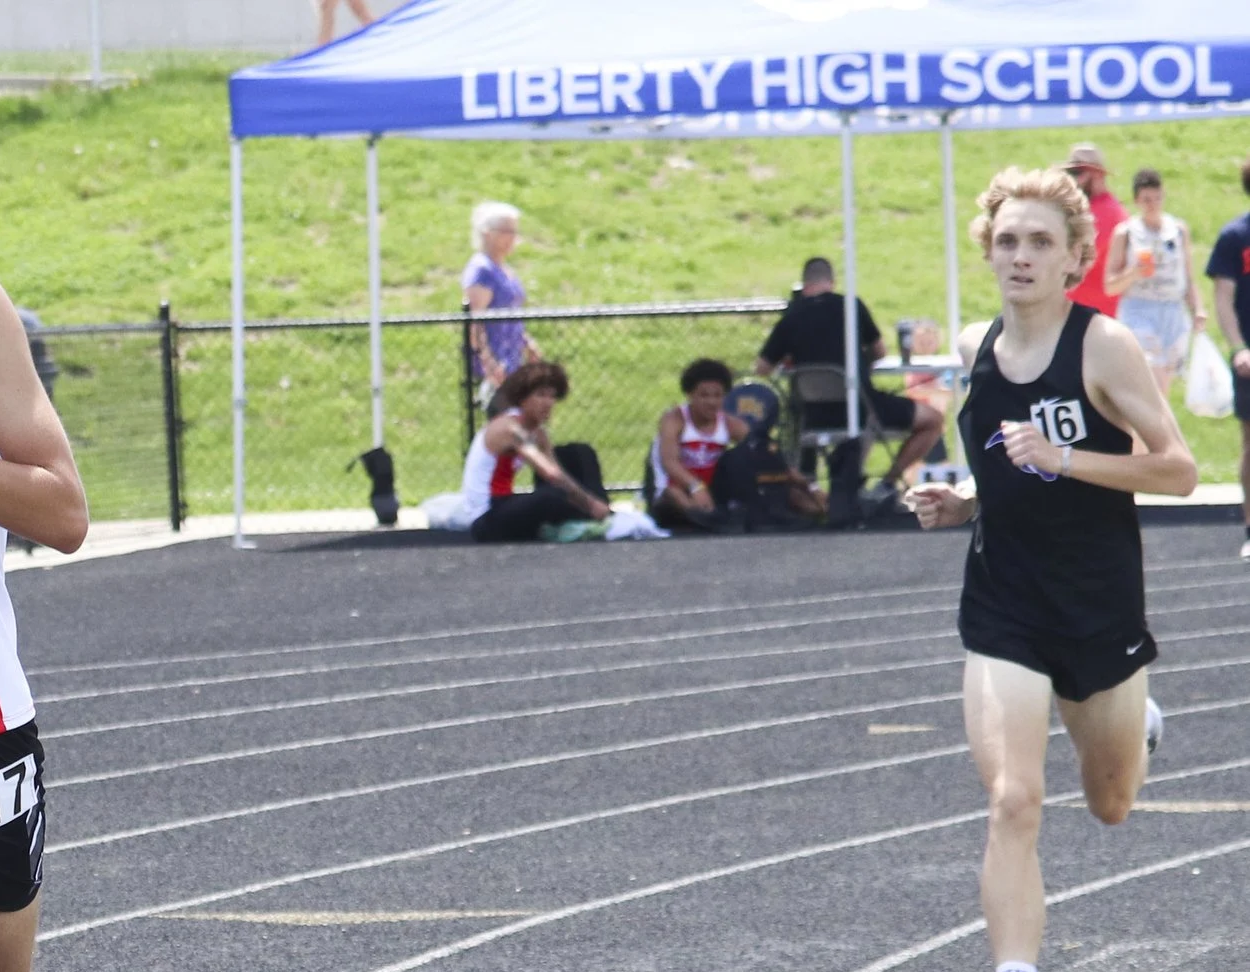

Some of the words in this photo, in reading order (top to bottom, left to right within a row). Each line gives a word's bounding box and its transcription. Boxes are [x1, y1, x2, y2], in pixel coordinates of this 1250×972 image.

[461, 57, 733, 120] LIBERTY
[752, 50, 921, 107] HIGH
[939, 45, 1232, 101] SCHOOL
[1035, 405, 1077, 441] 16
